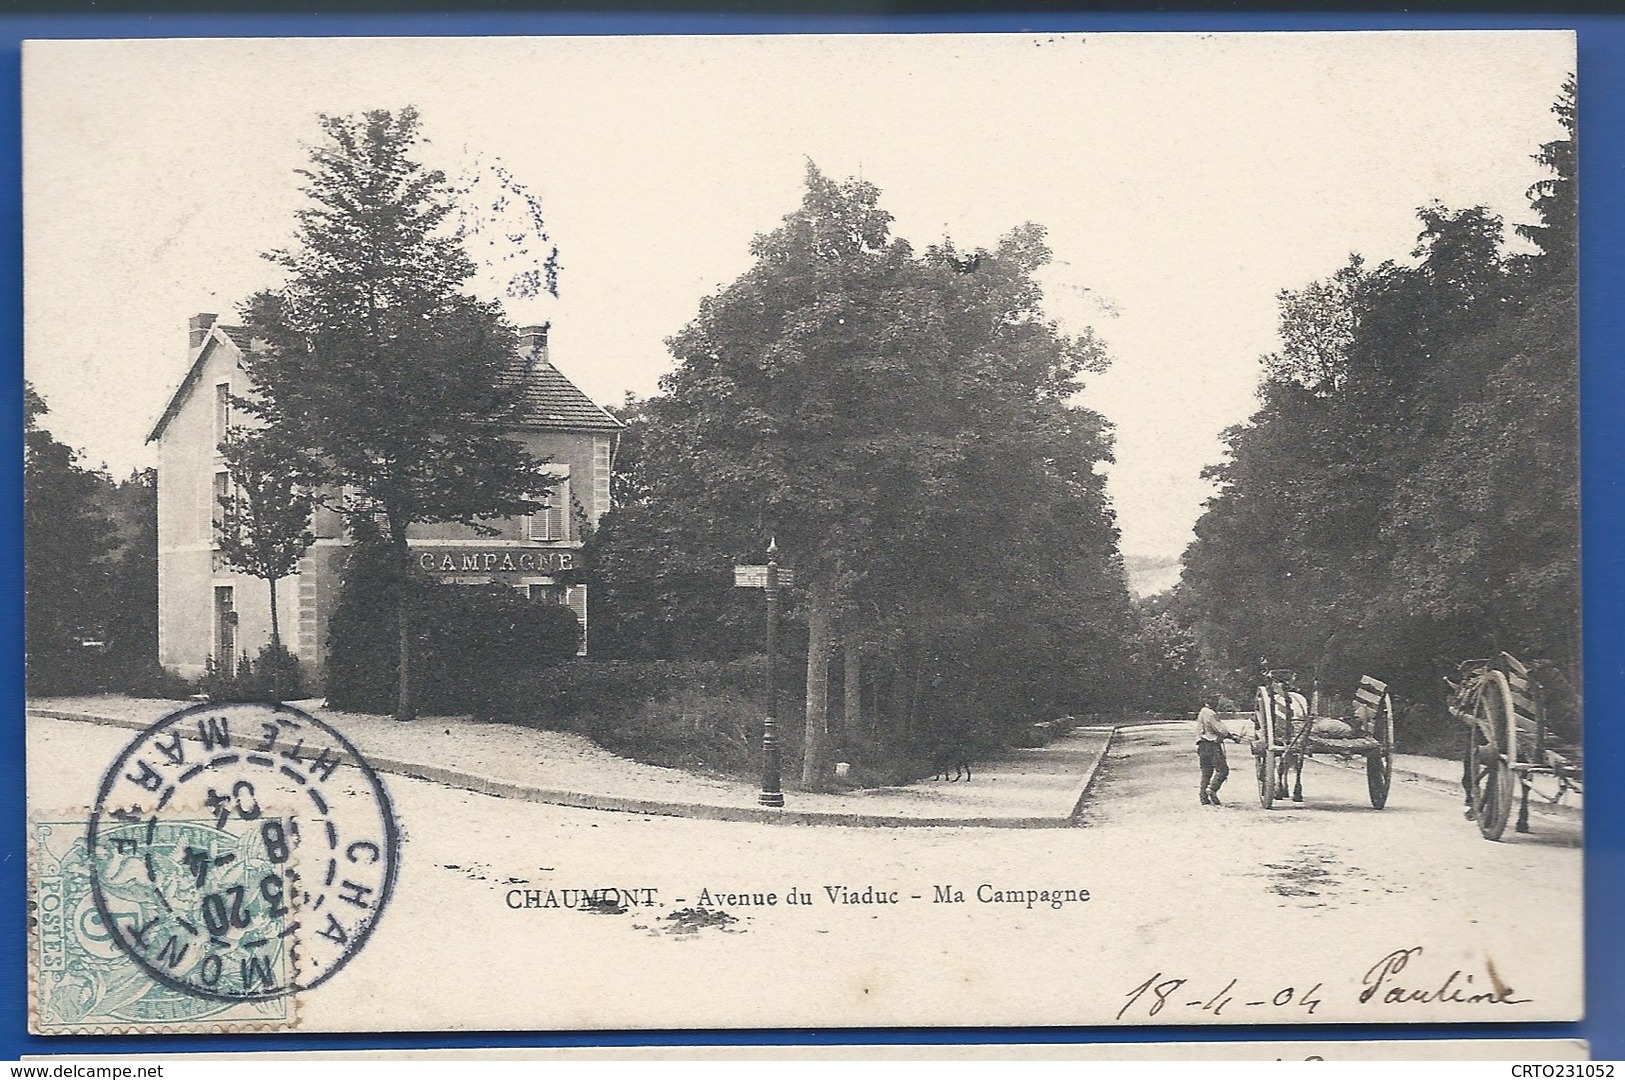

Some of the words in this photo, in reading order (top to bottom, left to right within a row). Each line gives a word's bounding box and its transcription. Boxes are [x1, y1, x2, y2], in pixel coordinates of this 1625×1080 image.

[420, 553, 573, 571] CAMPAGNE
[42, 879, 62, 972] POSTES
[128, 841, 380, 988] CHAMONT
[698, 886, 777, 906] Avenue
[787, 886, 813, 906] du
[824, 885, 899, 905] Viaduc
[933, 884, 965, 903] Ma
[977, 883, 1091, 910] Campagne
[1359, 945, 1533, 1005] Pauline
